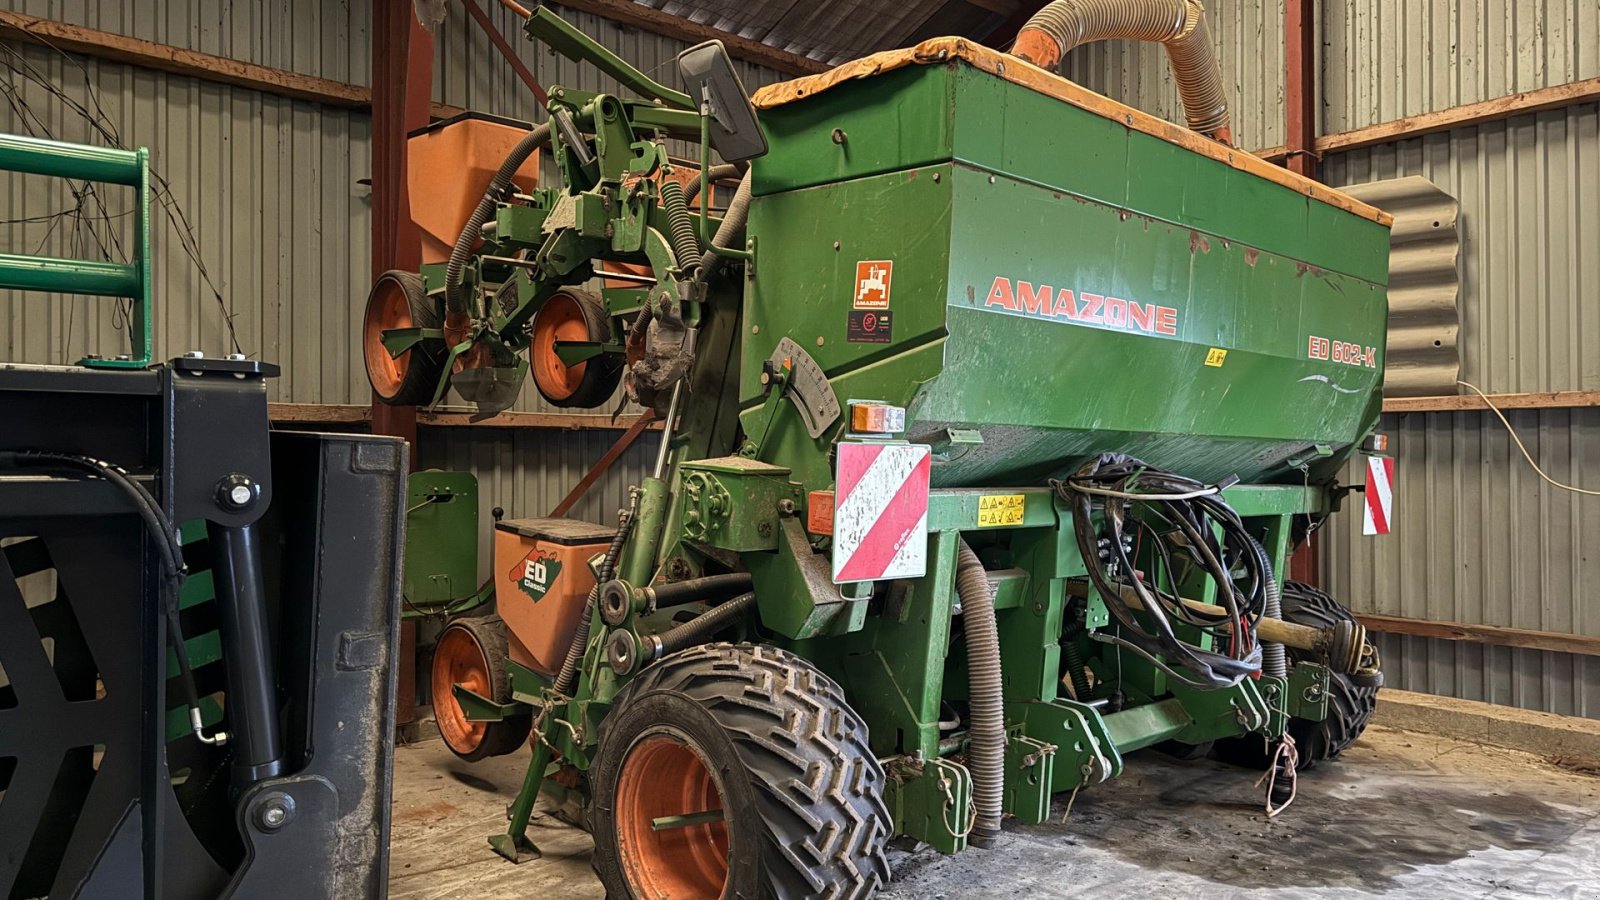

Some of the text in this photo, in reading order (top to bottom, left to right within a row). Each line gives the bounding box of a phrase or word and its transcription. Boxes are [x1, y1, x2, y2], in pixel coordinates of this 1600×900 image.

[985, 276, 1177, 335] AMAZONE
[1308, 335, 1377, 368] ED 602-K
[524, 559, 547, 584] ED
